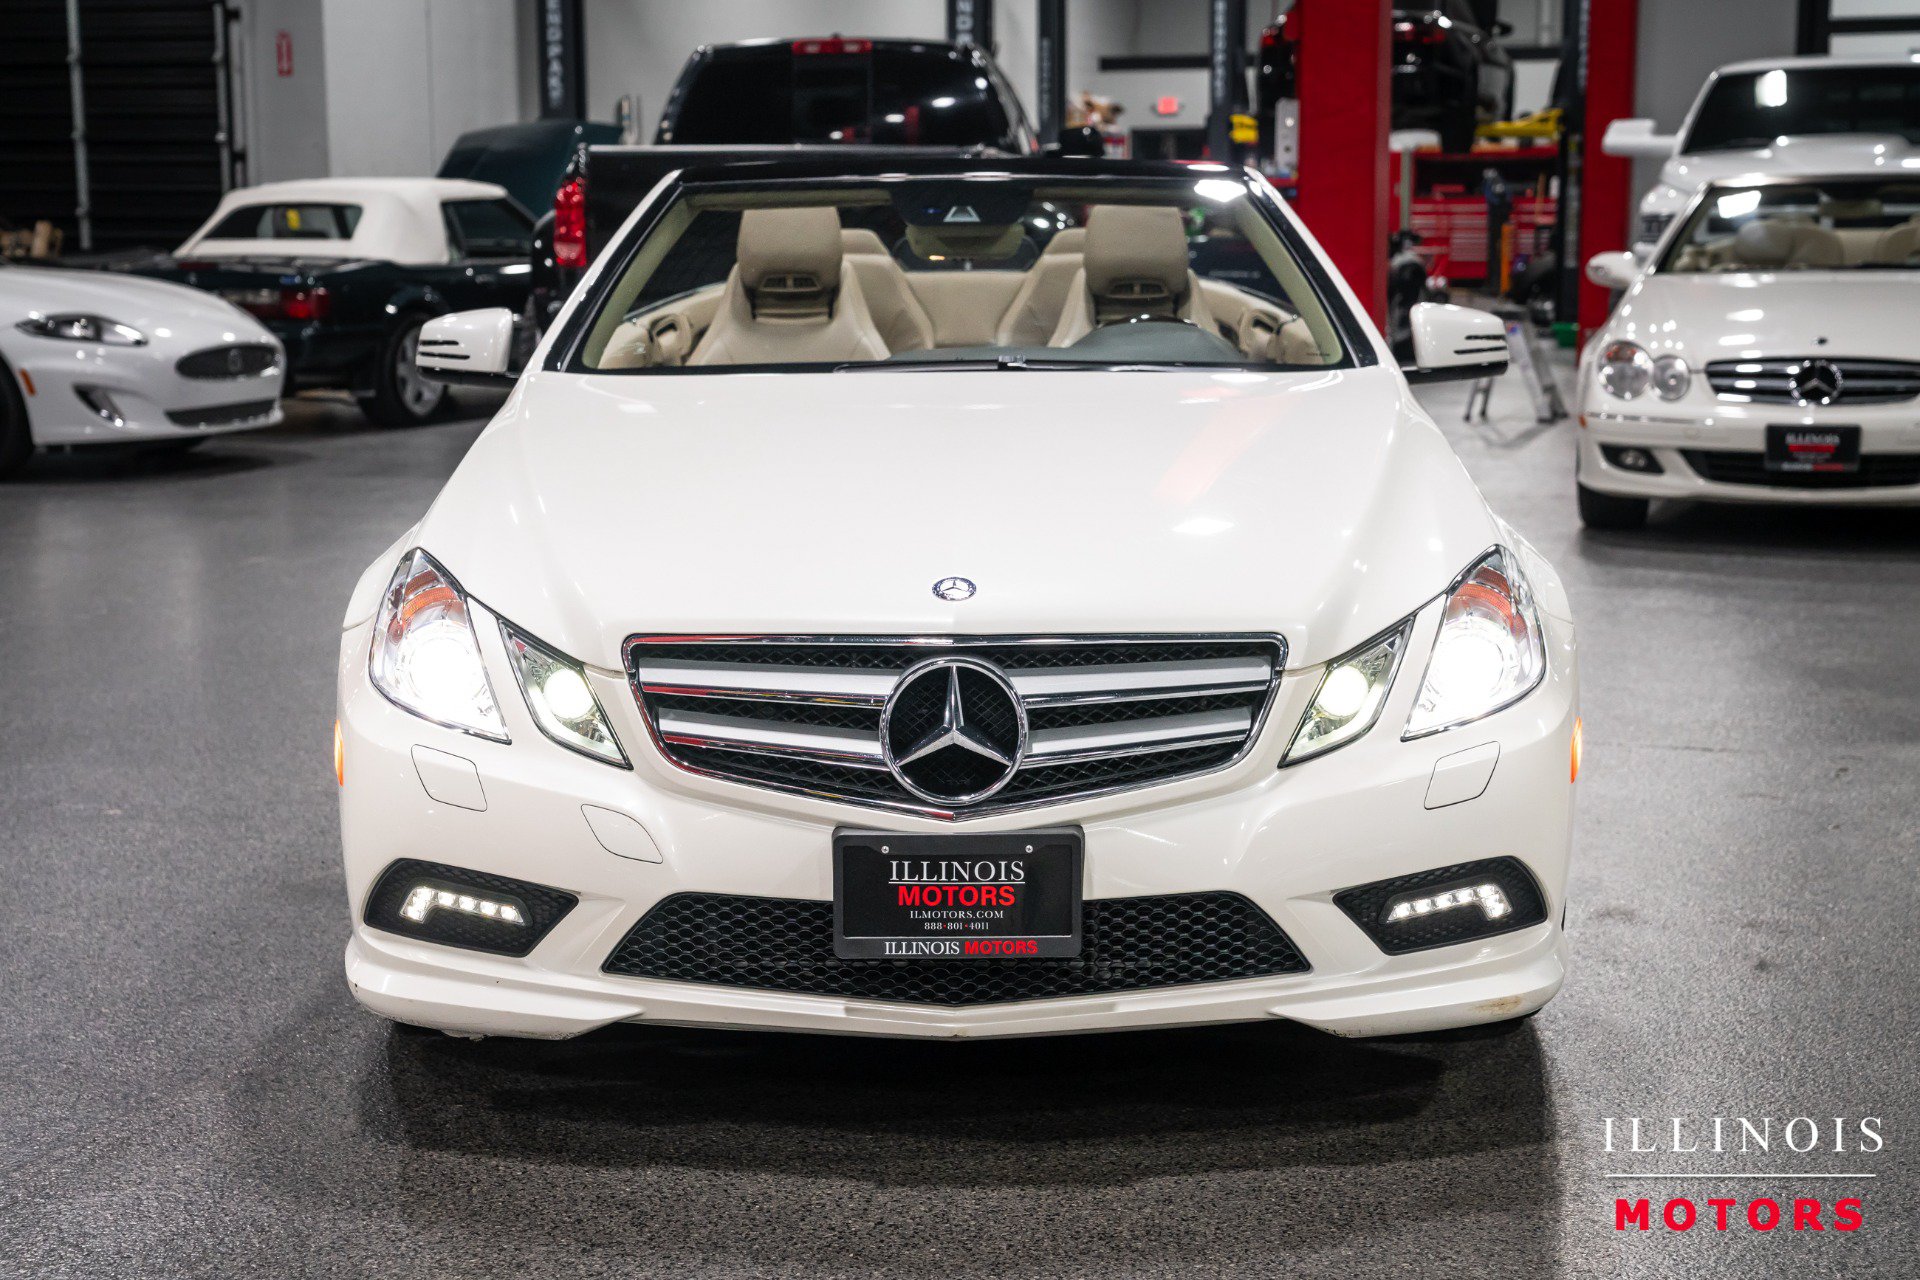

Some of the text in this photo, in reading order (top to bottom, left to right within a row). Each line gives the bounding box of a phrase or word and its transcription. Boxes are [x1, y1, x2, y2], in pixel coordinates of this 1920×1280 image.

[889, 860, 1025, 882] ILLINOIS
[898, 885, 1016, 906] MOTORS
[910, 910, 1004, 919] ILMOTORS.COM
[884, 940, 1039, 955] ILLINOIS MOTORS
